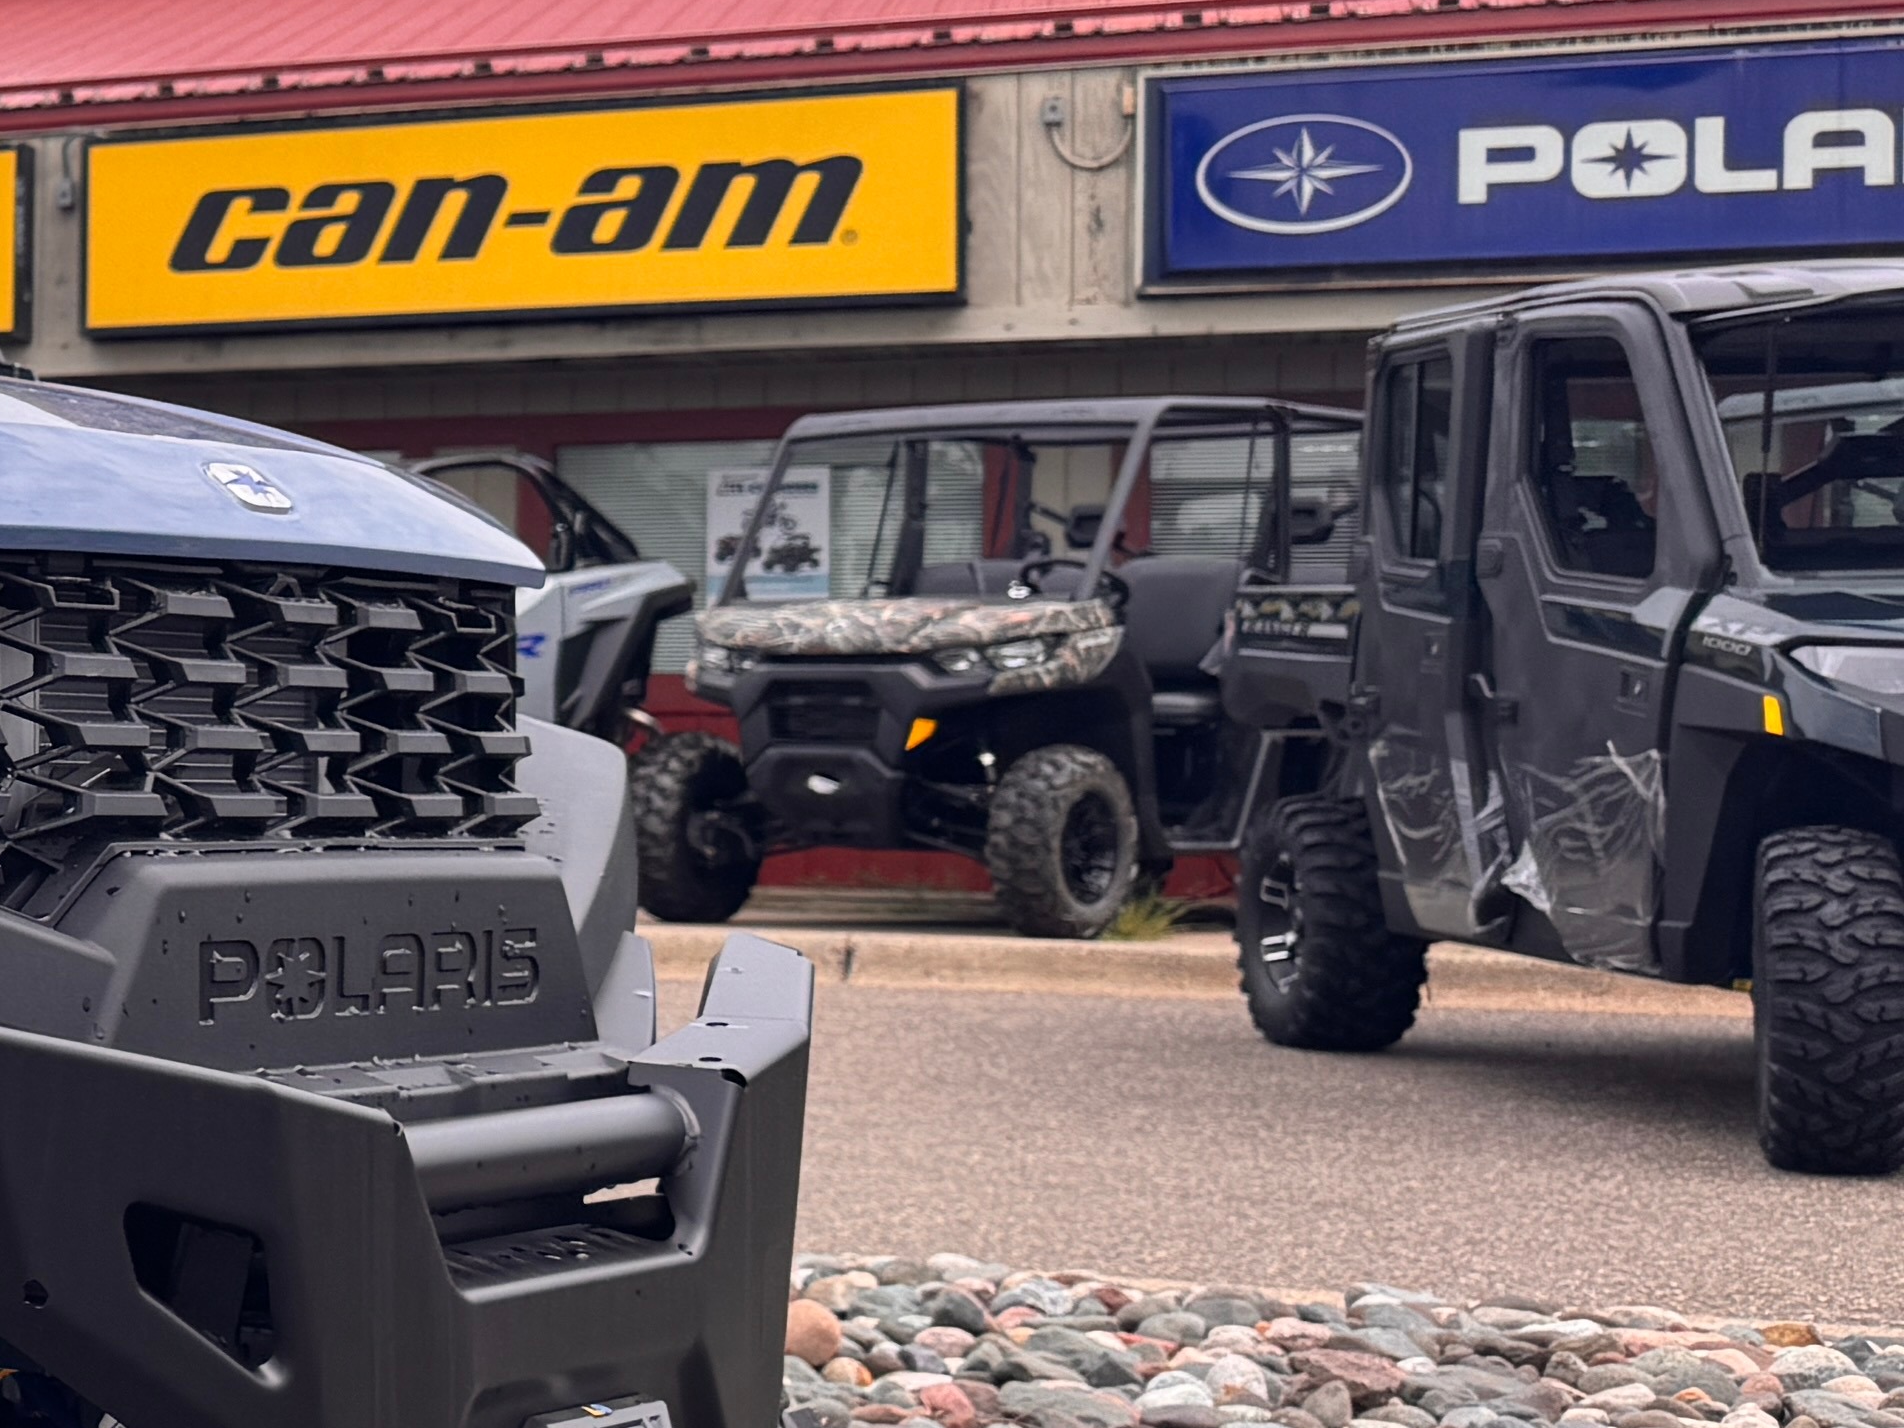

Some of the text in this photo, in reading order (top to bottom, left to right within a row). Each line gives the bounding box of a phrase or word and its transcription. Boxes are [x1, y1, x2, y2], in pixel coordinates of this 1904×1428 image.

[1457, 108, 1904, 205] POLA
[168, 155, 864, 274] can-am
[197, 926, 543, 1027] POLARIS
